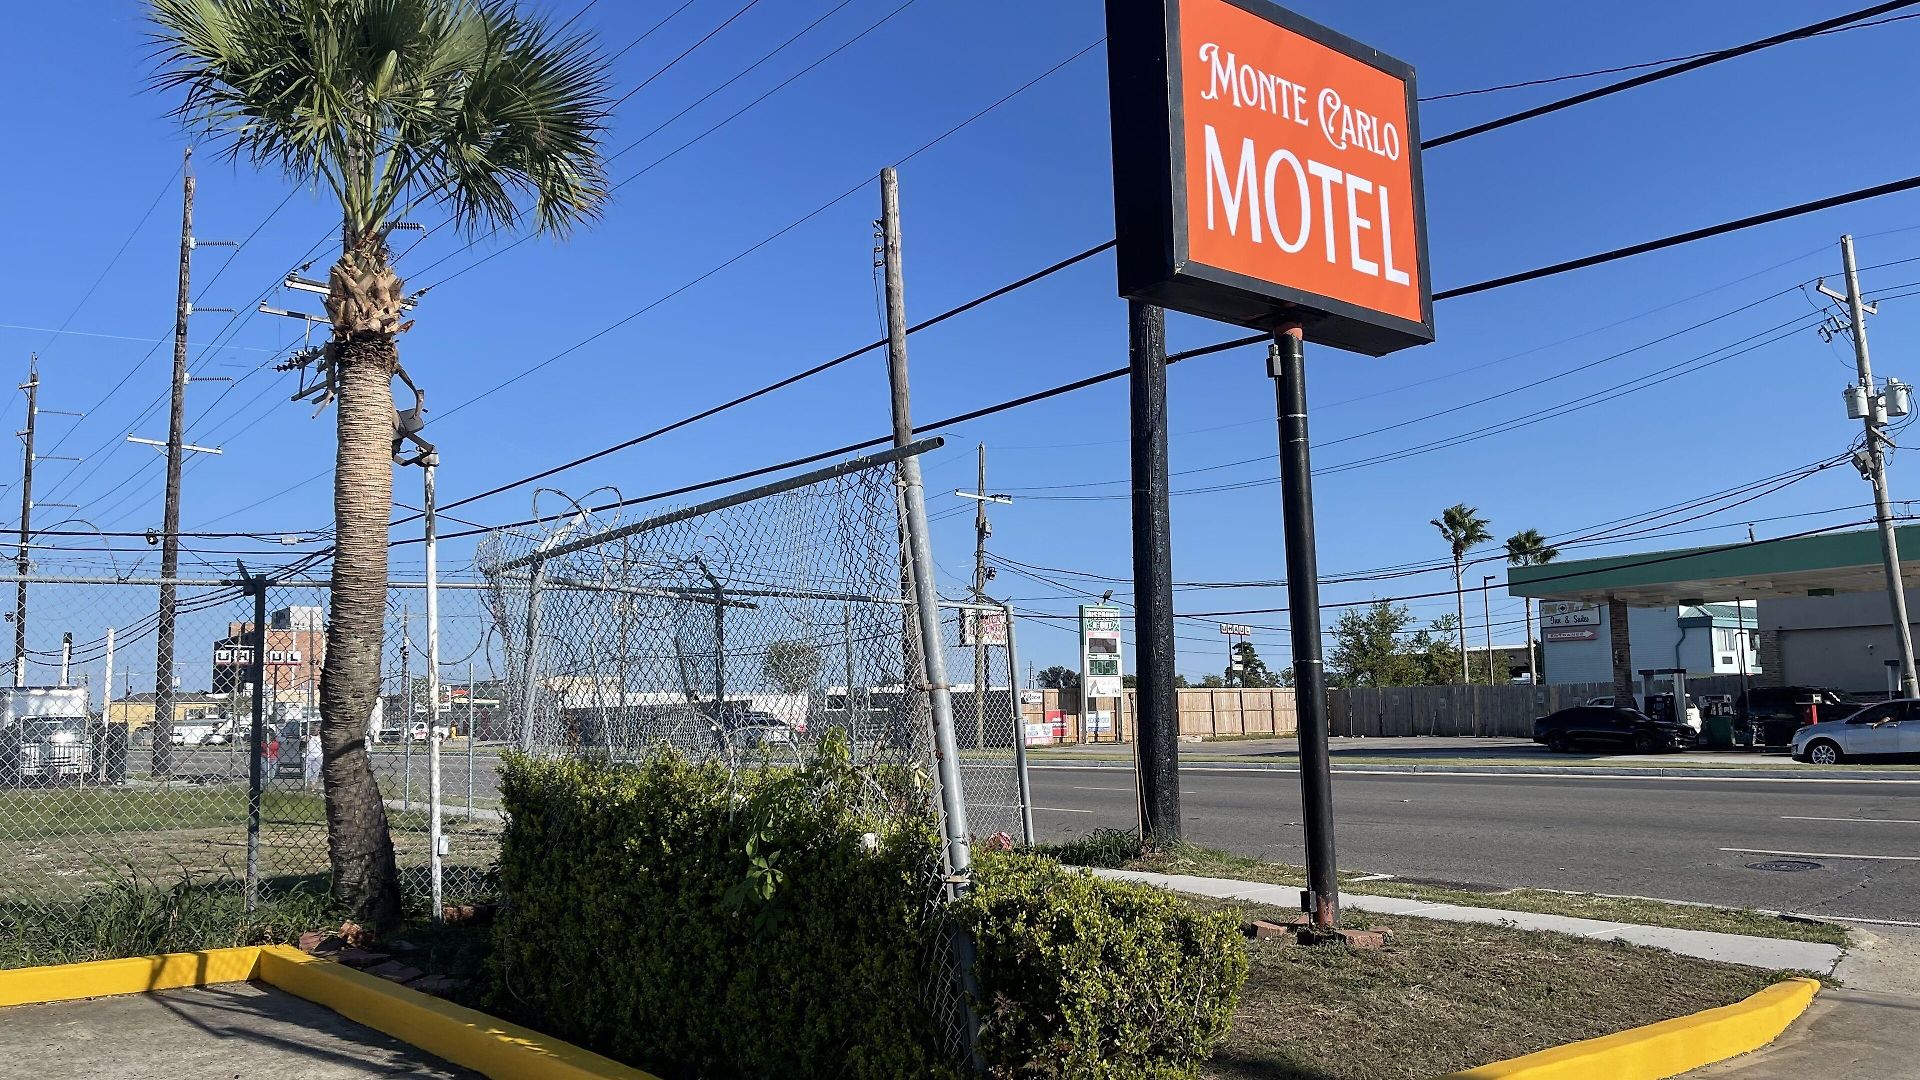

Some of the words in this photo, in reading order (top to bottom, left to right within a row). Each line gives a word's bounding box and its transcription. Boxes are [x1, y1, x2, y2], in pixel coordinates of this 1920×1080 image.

[1199, 42, 1309, 127] MONTE
[1317, 87, 1400, 161] CARLO
[1203, 124, 1410, 287] MOTEL
